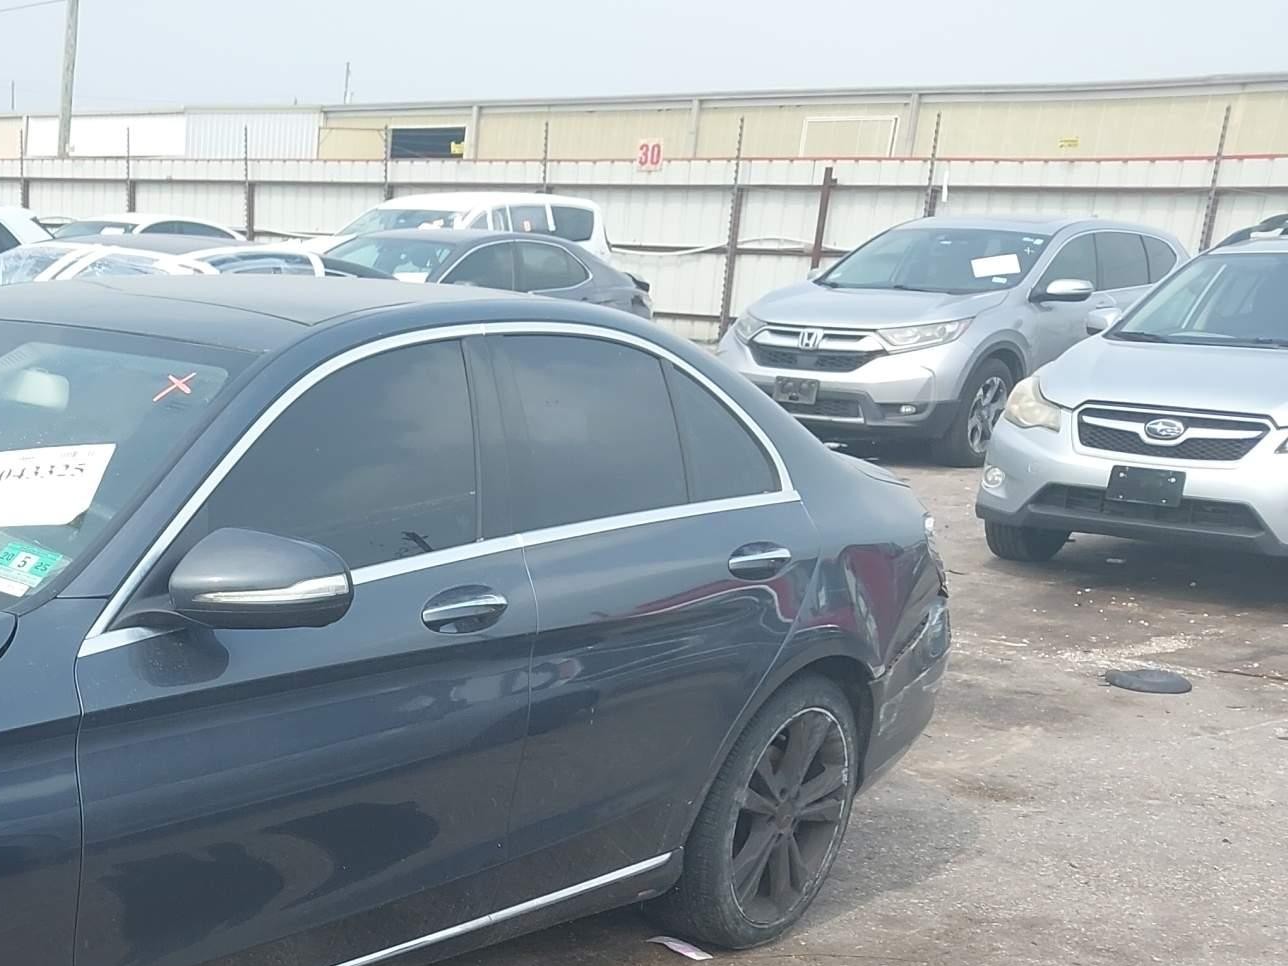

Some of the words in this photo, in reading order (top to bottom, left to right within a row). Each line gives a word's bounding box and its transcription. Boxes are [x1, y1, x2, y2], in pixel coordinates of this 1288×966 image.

[638, 143, 661, 166] 30
[0, 551, 15, 562] 20
[17, 555, 32, 568] 5
[34, 562, 51, 572] 25
